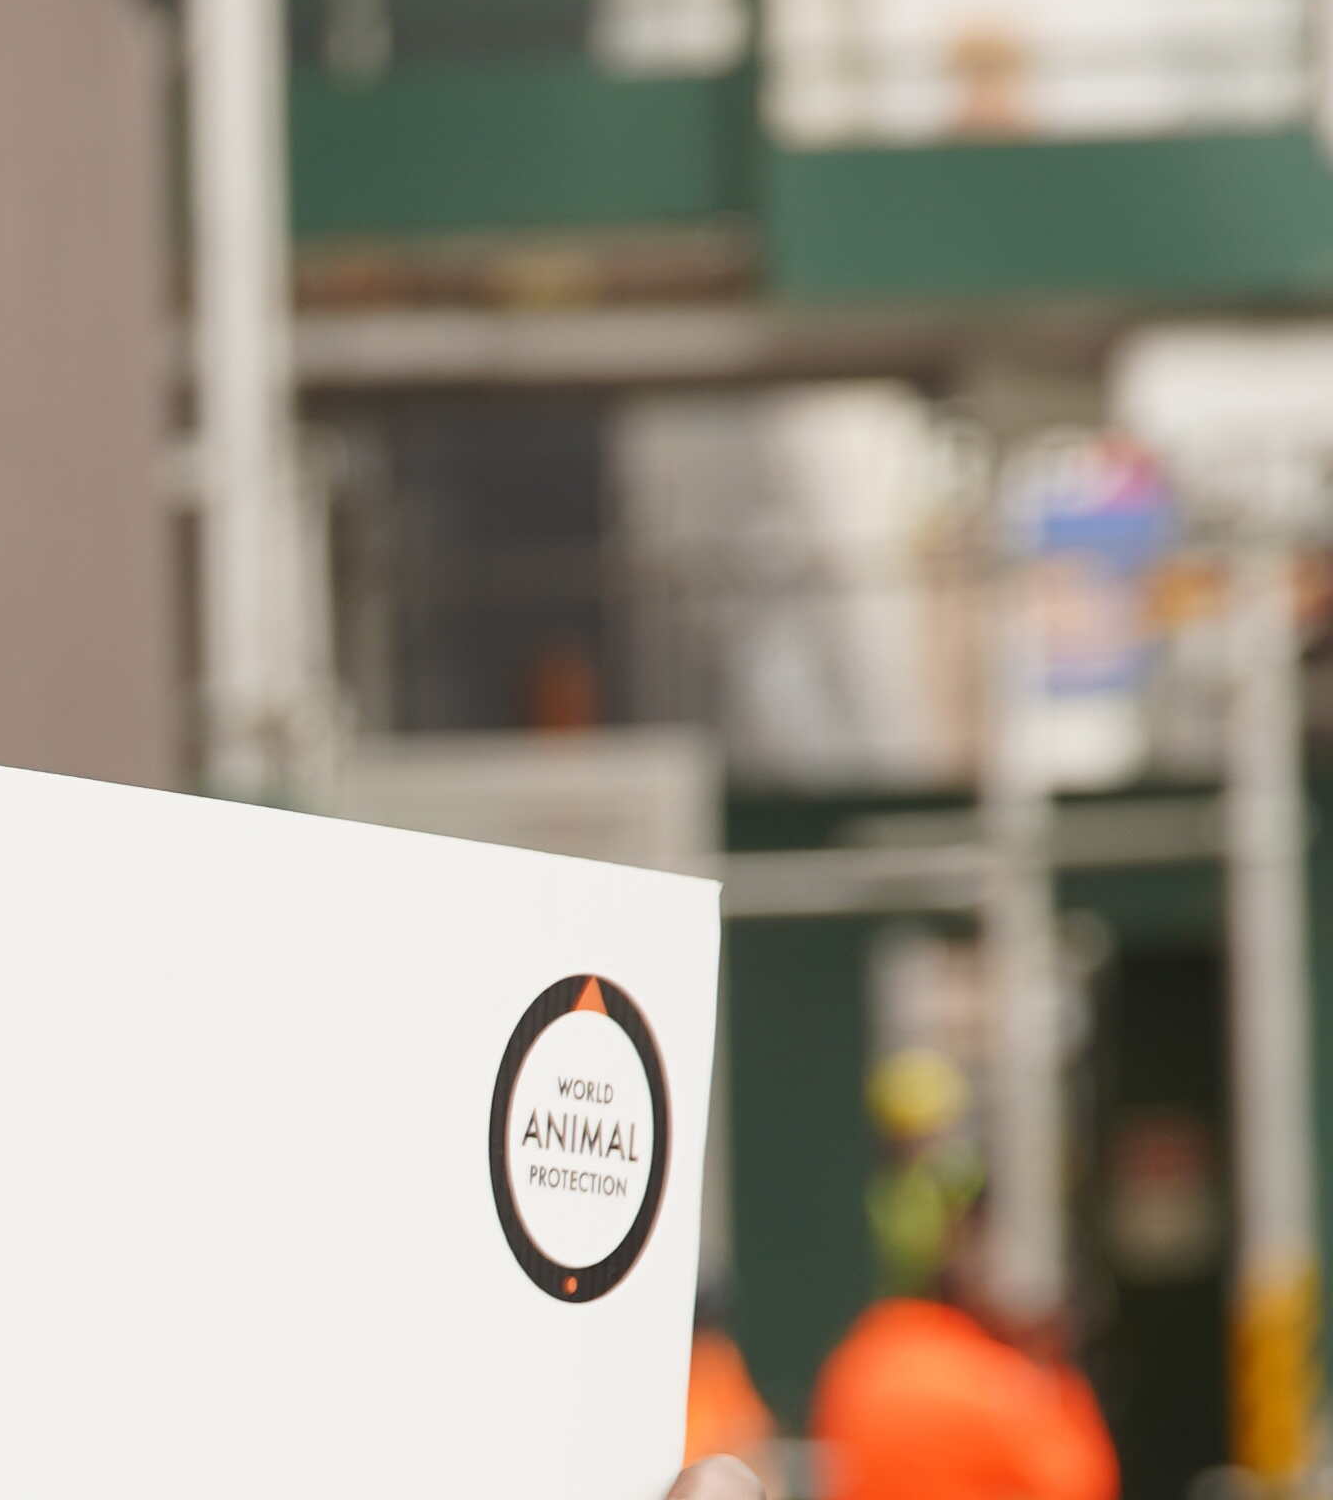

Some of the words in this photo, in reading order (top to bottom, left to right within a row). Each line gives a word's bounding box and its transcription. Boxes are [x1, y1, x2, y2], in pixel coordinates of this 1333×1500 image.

[557, 1075, 615, 1105] WORLD
[521, 1107, 639, 1163] ANIMAL
[528, 1163, 629, 1198] PROTECTION
